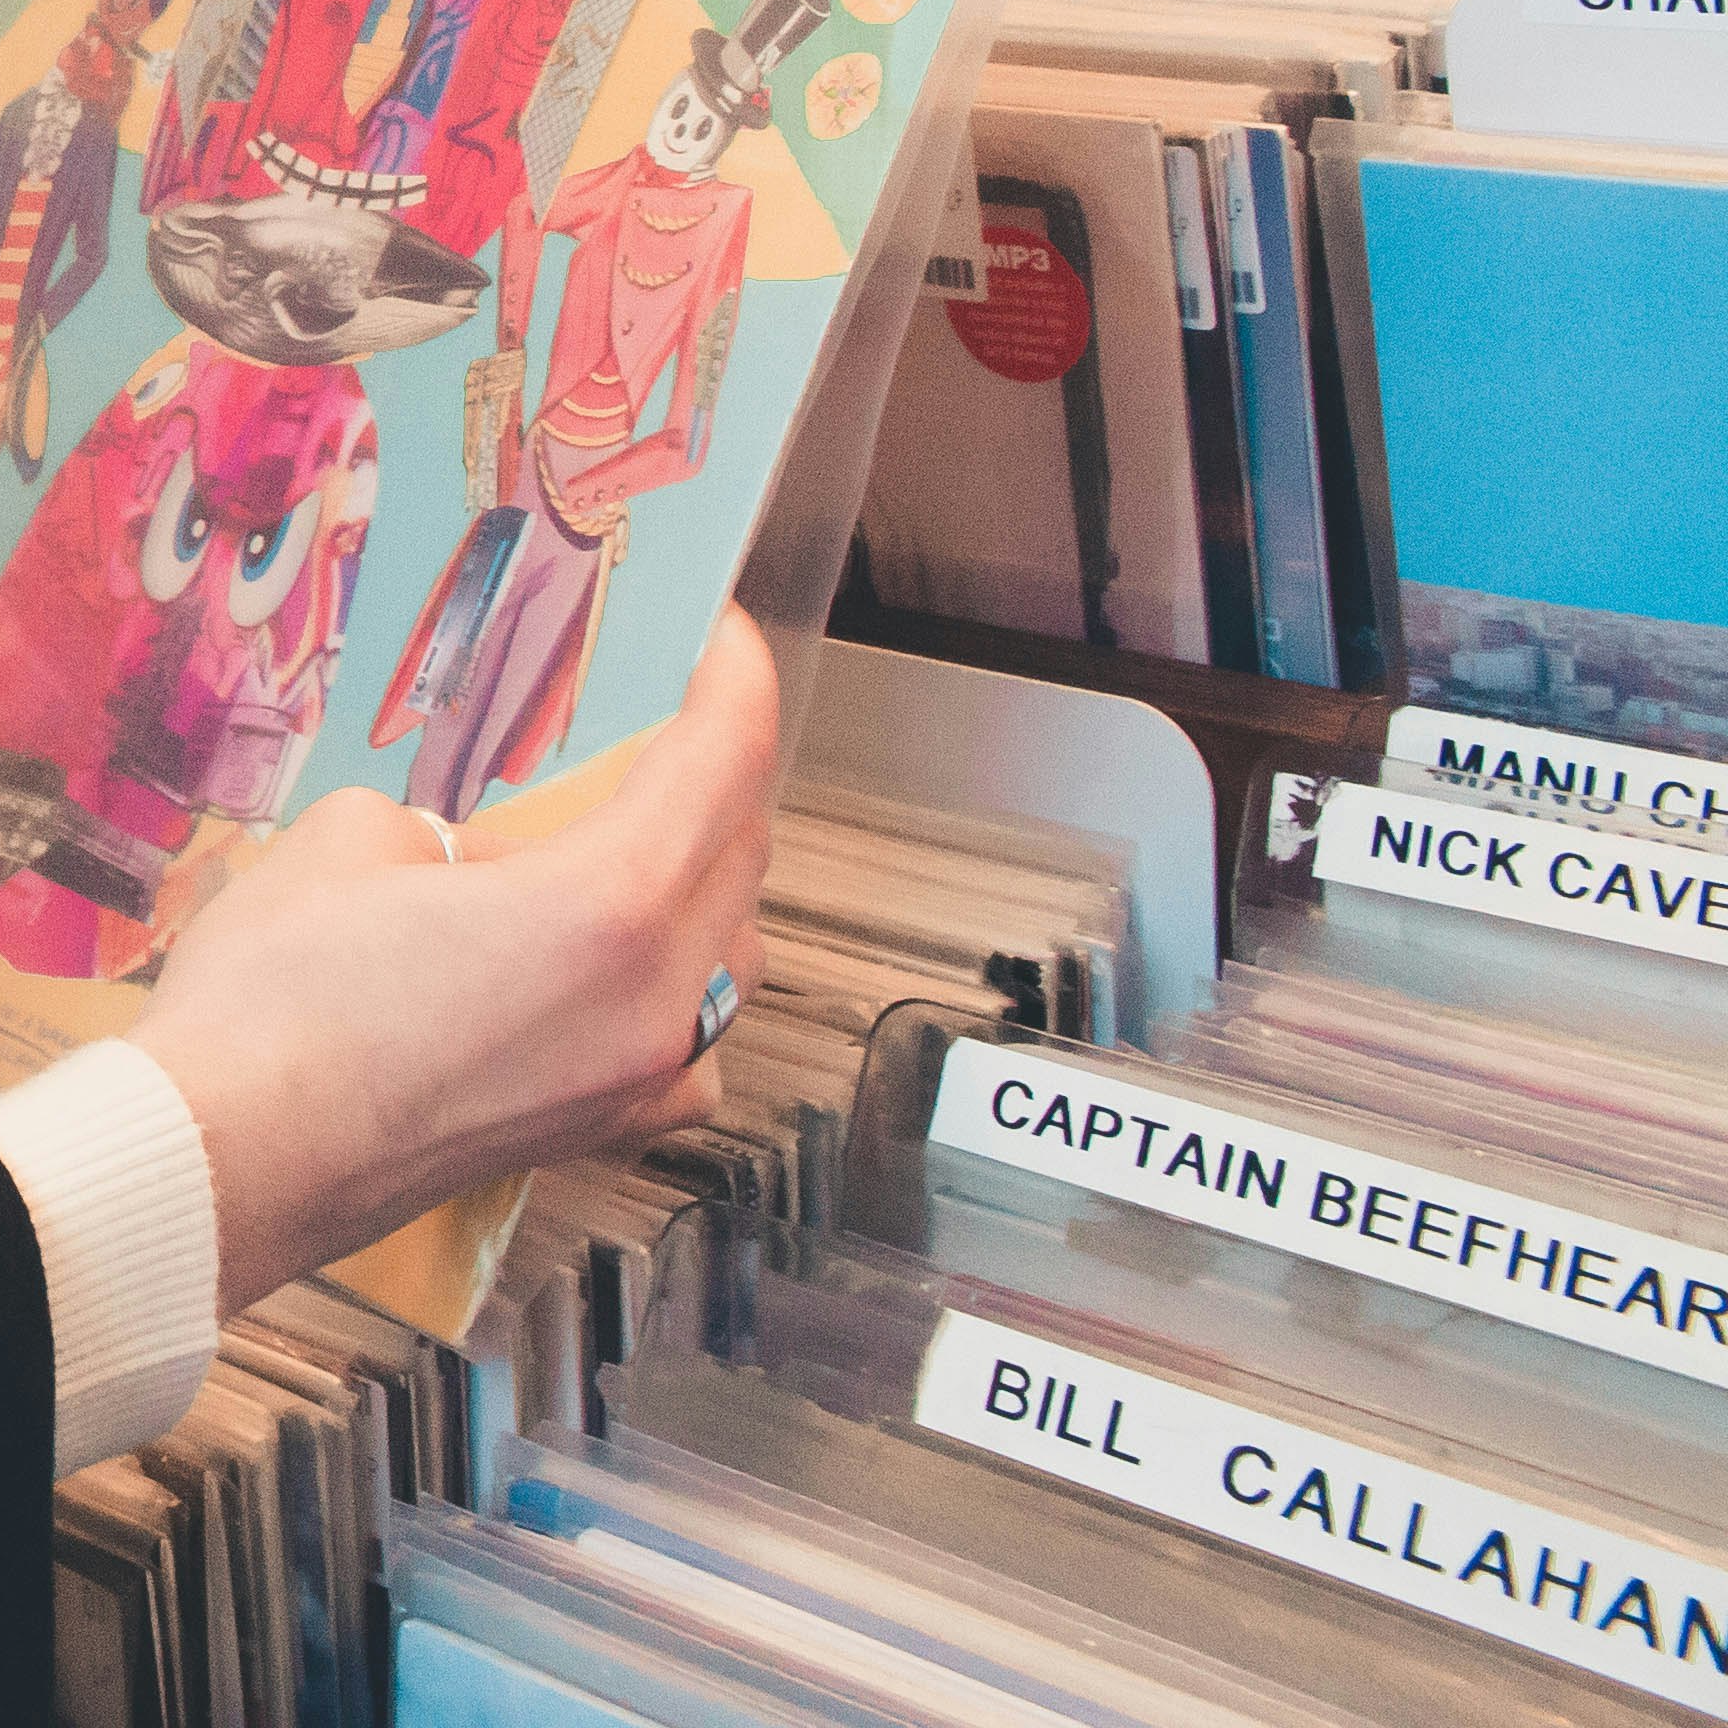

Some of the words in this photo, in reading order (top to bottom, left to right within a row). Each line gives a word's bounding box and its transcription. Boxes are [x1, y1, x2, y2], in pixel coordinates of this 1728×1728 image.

[985, 244, 1050, 272] MP3
[1438, 736, 1629, 813] MANU
[1368, 814, 1528, 892] NICK
[1548, 849, 1728, 928] CAVE
[990, 1077, 1290, 1210] CAPTAIN
[1309, 1169, 1728, 1347] BEEFHEAR
[983, 1357, 1142, 1467] BILL
[1221, 1443, 1728, 1675] CALLAHAN
